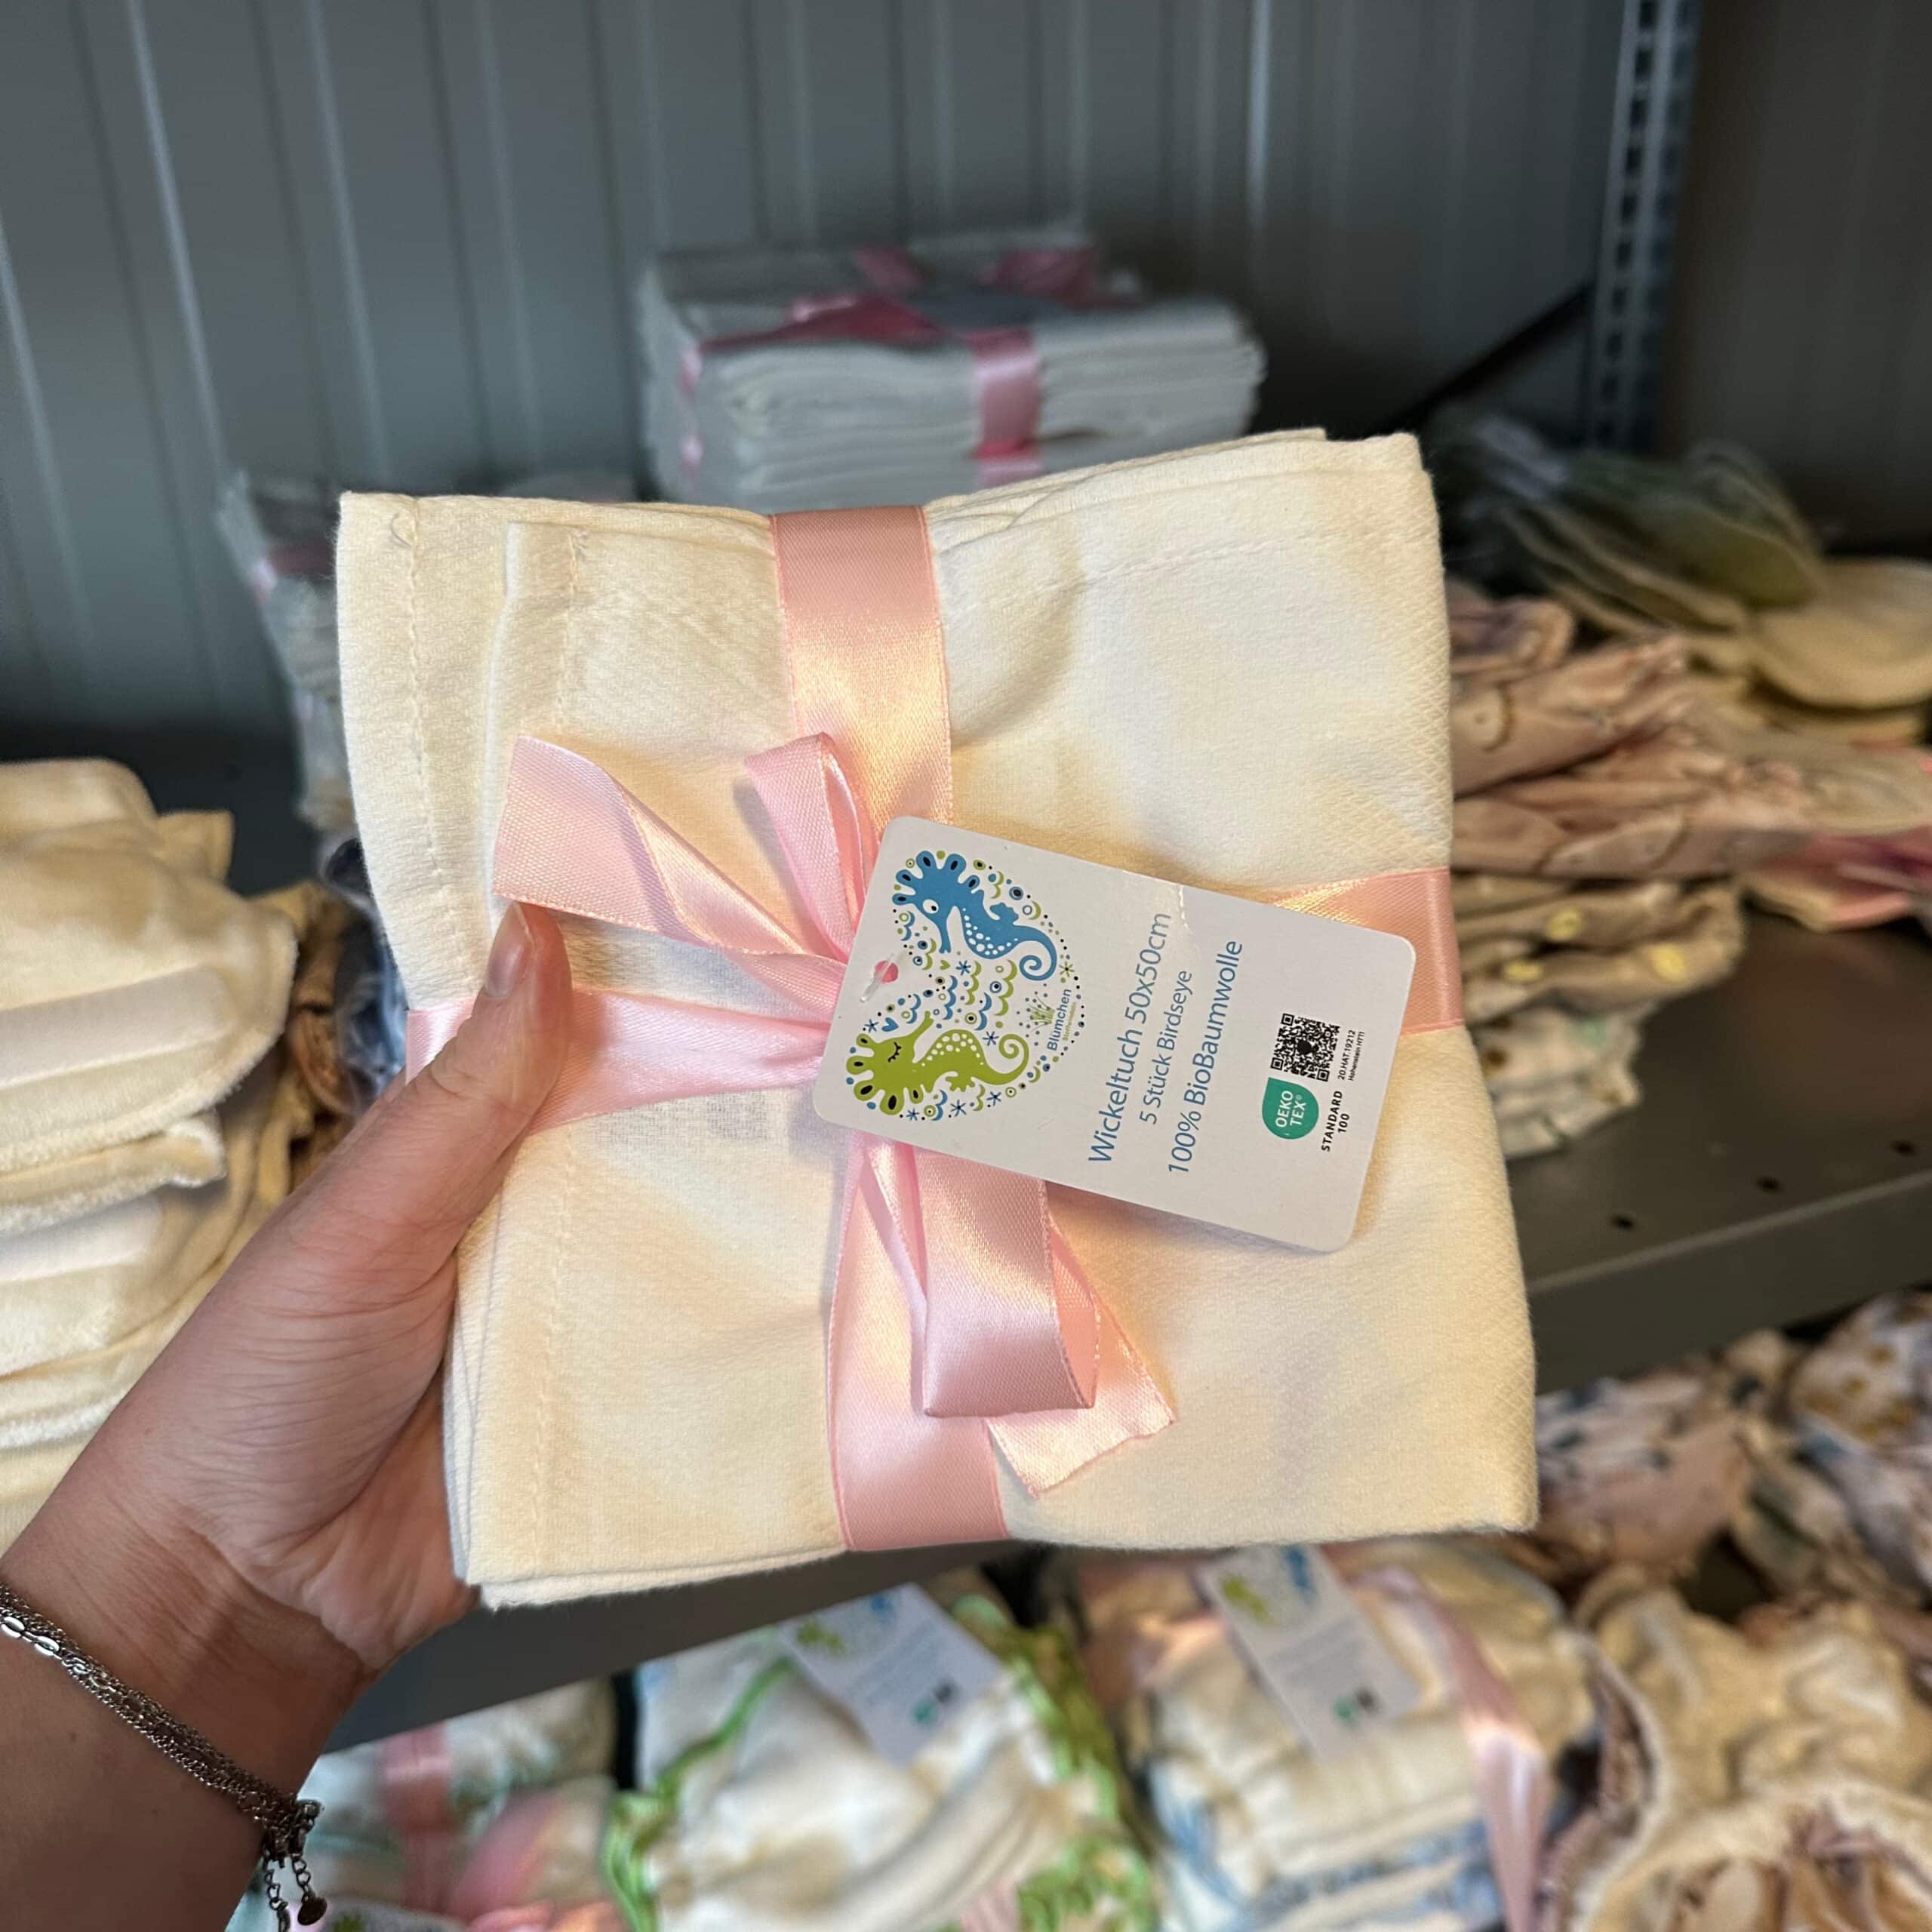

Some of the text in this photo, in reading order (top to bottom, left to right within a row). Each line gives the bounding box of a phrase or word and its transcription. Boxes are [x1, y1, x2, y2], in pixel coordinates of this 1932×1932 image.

[1047, 989, 1072, 1051] Blümchen
[1088, 913, 1171, 1161] Wickeltuch 50x50cm
[1140, 971, 1192, 1124] 5 Stück Birdseye
[1168, 941, 1242, 1172] 100% BioBaumwolle
[1338, 1029, 1355, 1080] 20.HAT.19212
[1275, 1091, 1294, 1128] OEKO
[1321, 1091, 1343, 1152] STANDARD
[1338, 1113, 1350, 1133] 100
